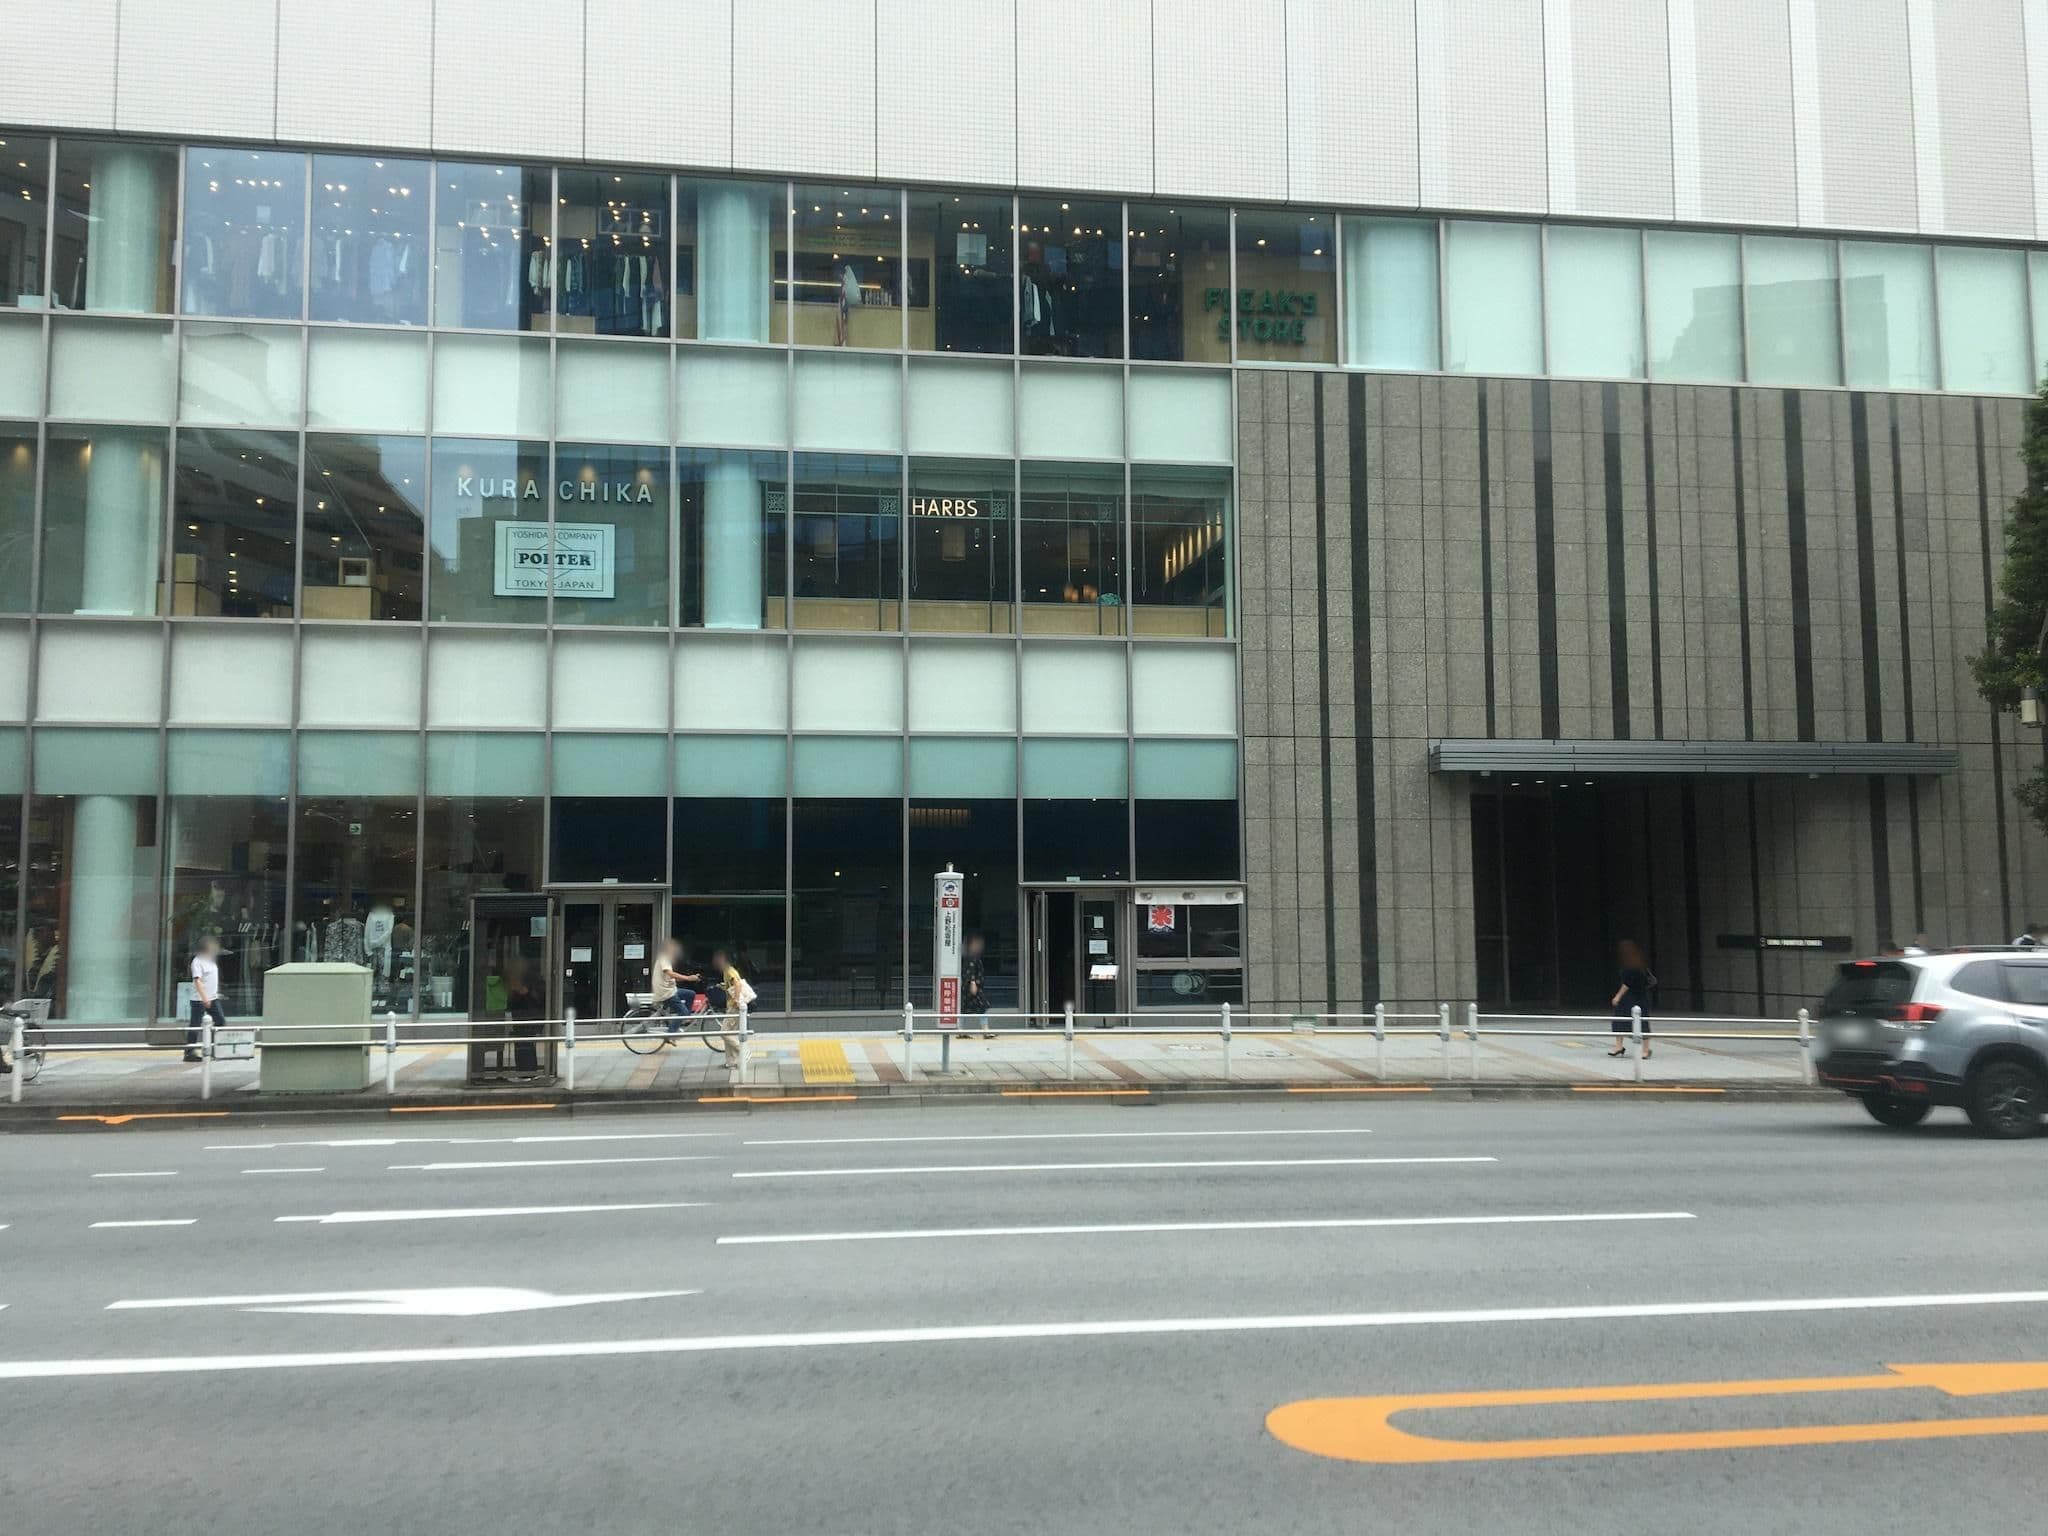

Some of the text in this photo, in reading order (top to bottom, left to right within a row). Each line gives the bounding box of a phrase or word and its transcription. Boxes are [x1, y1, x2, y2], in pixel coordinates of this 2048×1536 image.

[1218, 314, 1306, 343] STORE
[457, 477, 652, 503] KURA CHIKA
[912, 498, 978, 517] HARBS
[513, 531, 548, 539] YOSHIDA
[558, 532, 597, 540] COMPANY
